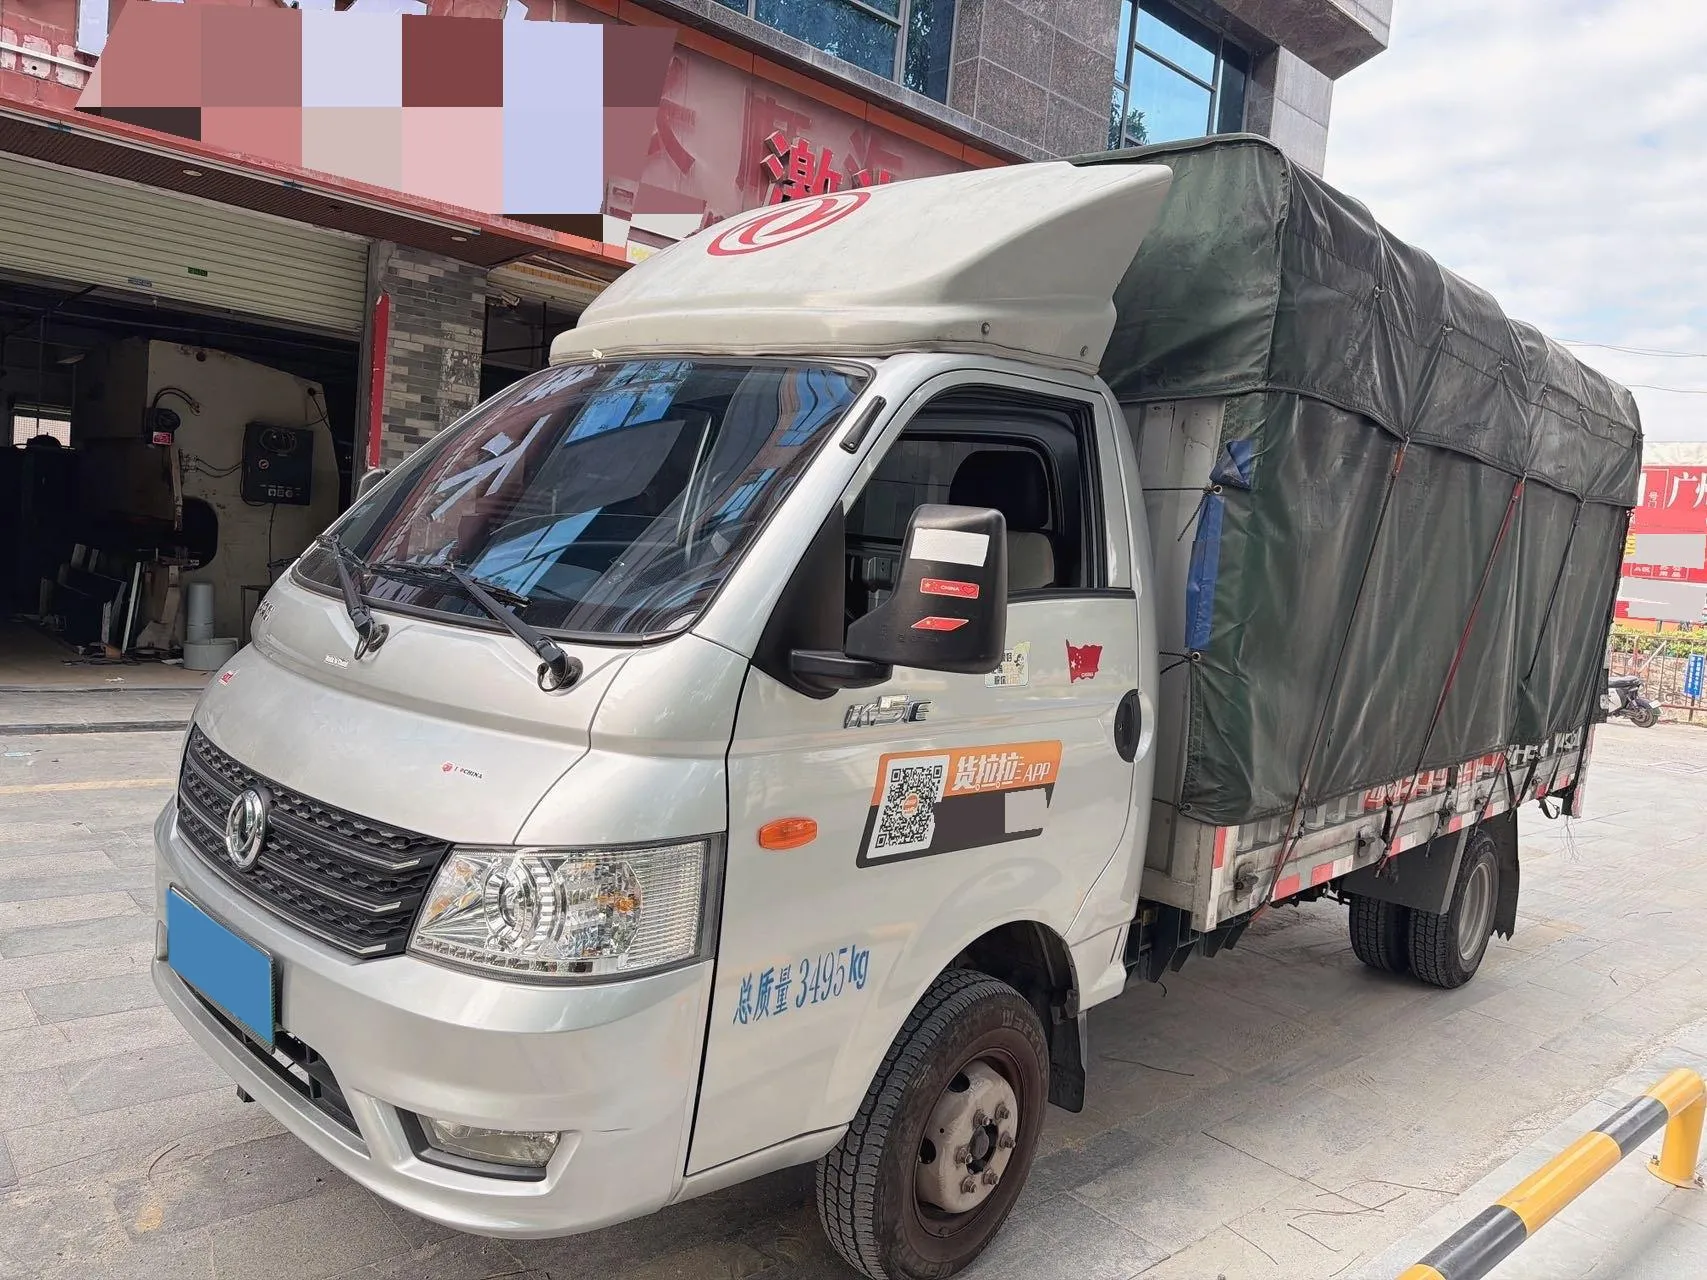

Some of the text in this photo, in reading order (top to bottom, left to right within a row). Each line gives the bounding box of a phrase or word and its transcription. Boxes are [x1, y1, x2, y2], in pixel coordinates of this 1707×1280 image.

[463, 768, 483, 779] CHINA
[952, 752, 1051, 791] 货拉拉 APP
